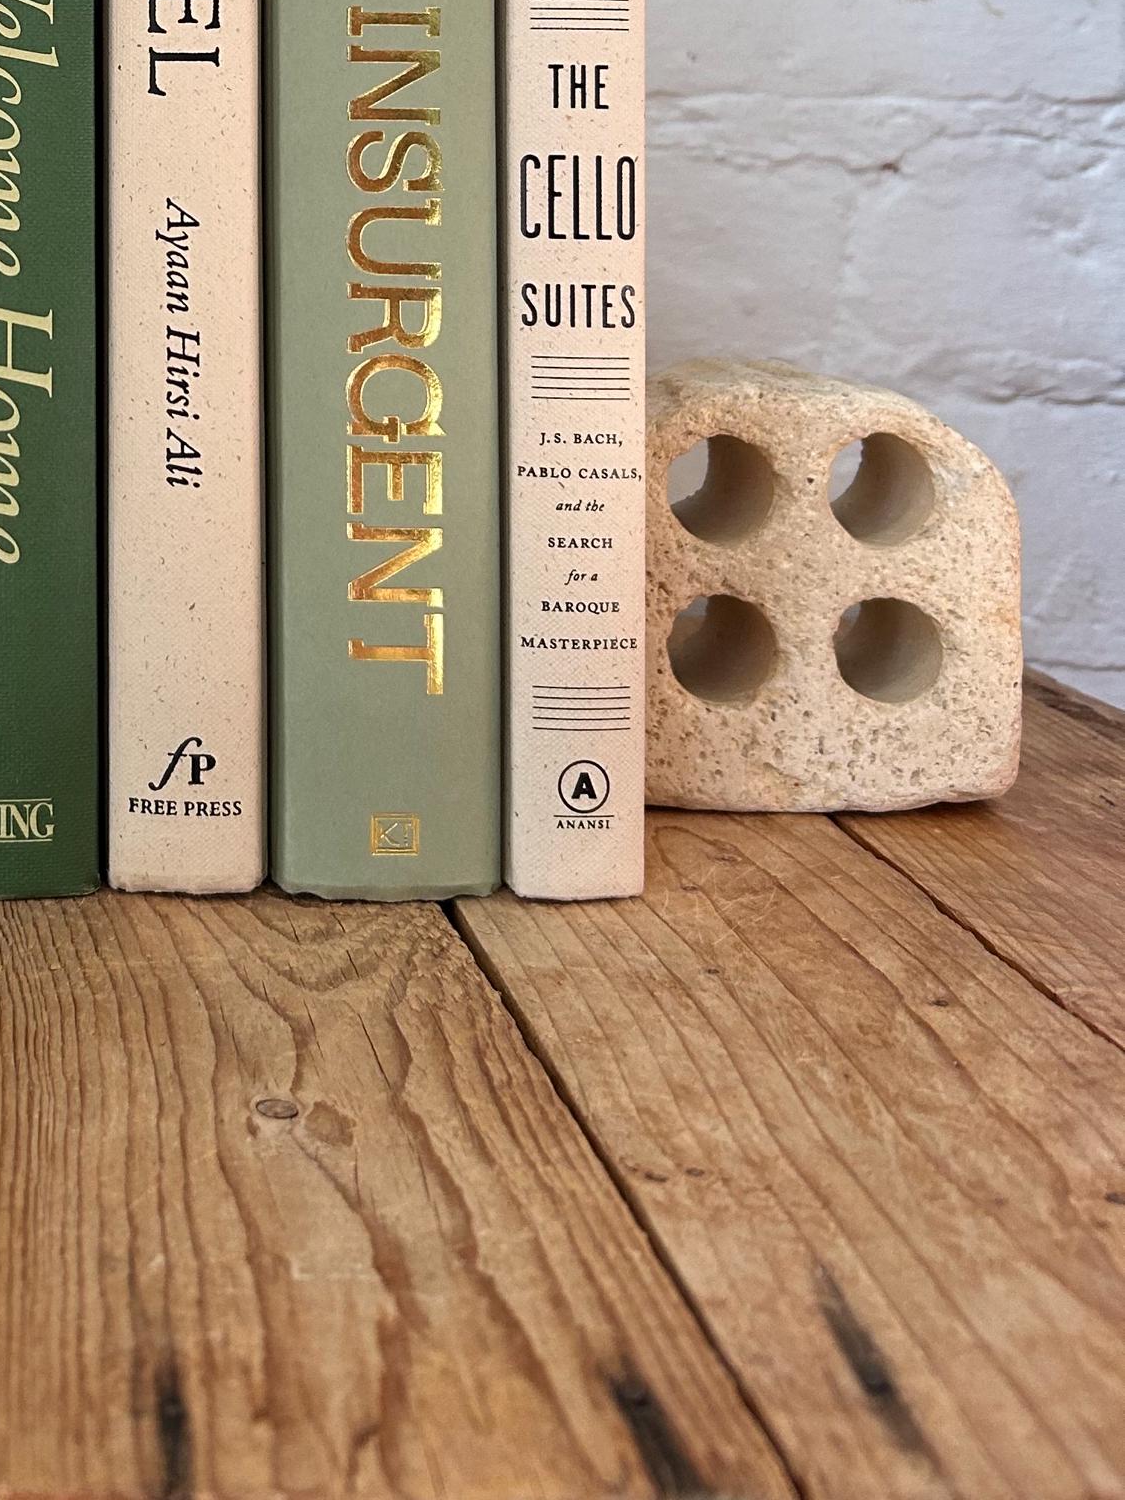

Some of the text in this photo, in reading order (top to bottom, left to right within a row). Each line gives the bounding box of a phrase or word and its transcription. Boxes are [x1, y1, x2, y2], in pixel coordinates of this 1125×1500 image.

[547, 64, 610, 110] THE
[520, 154, 636, 241] CELLO
[521, 282, 636, 329] SUITES
[154, 196, 201, 489] Ayaan Hirsi Ali
[345, 5, 446, 695] INSURGENT
[573, 433, 624, 448] BACH,
[517, 465, 643, 482] PABLO CASALS,
[555, 500, 605, 512] and the
[547, 536, 614, 550] SEARCH
[564, 569, 598, 585] for a
[541, 600, 620, 615] BAROQUE
[521, 636, 638, 651] MASTERPIECE
[571, 772, 598, 800] A
[128, 796, 243, 818] FREE PRESS
[556, 819, 611, 831] ANANSI
